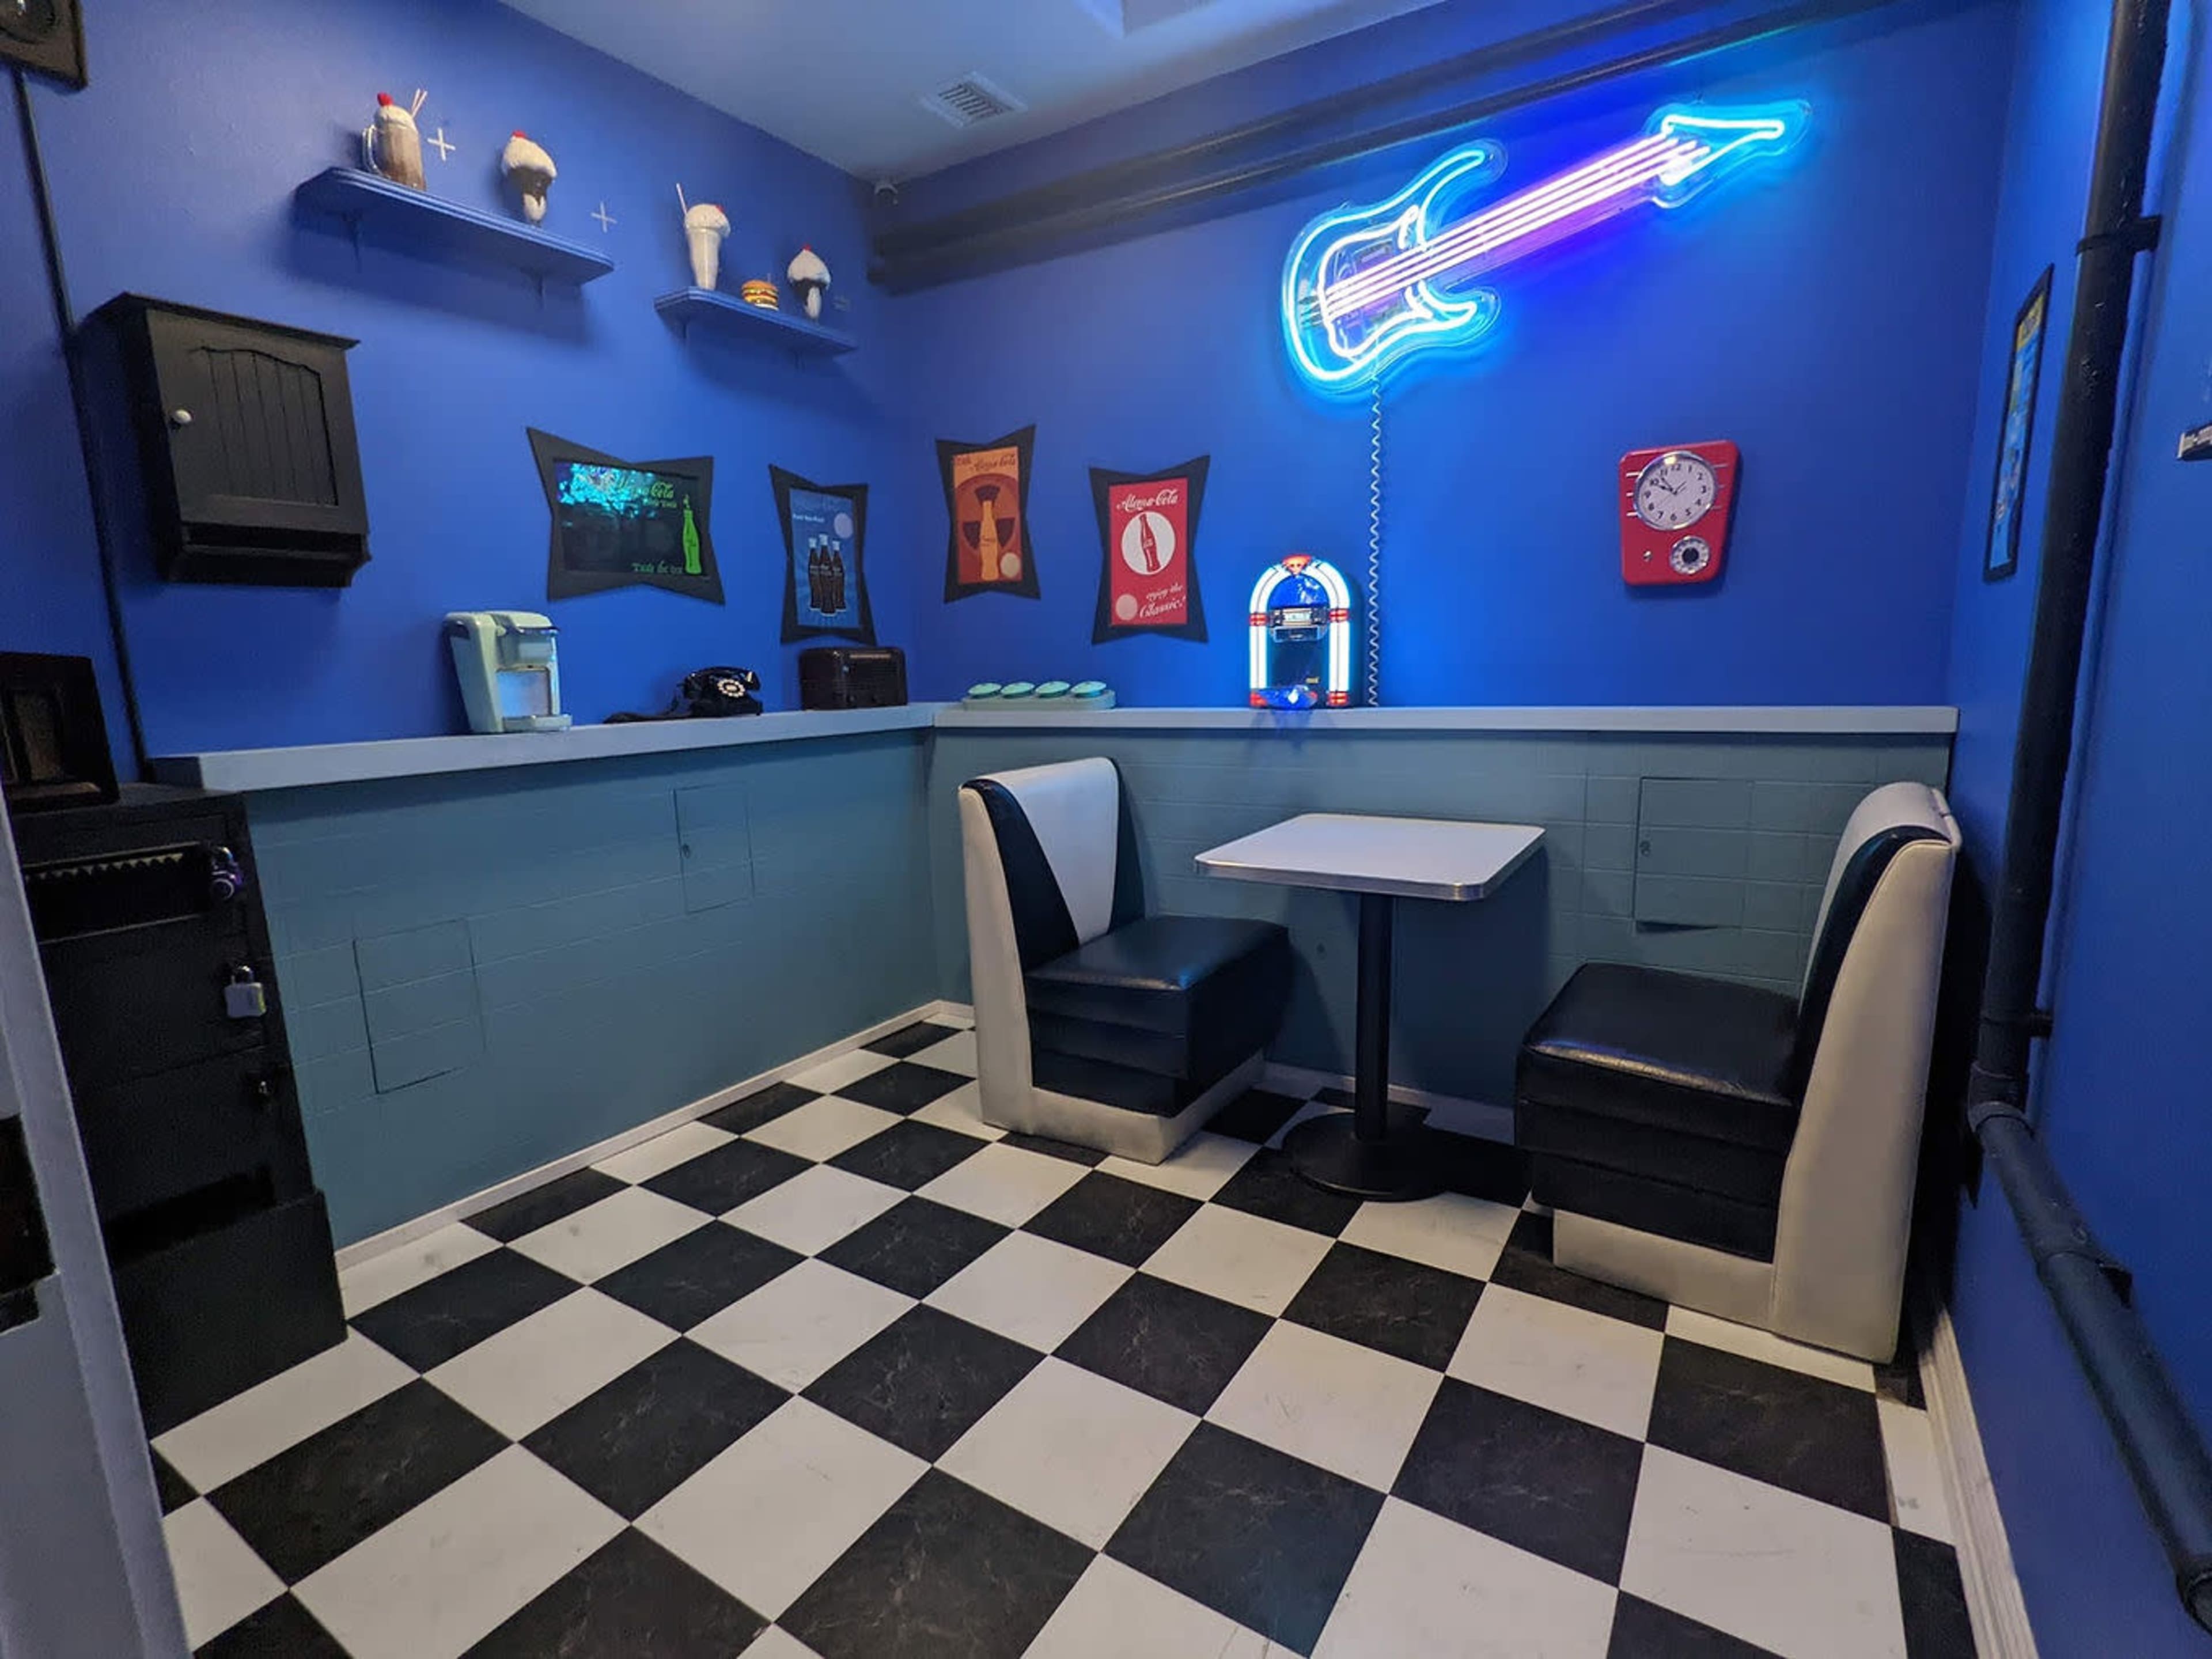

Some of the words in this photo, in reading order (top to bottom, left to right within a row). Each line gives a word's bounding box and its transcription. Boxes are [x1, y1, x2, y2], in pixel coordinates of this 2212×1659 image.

[1688, 465, 1692, 473] 1
[1697, 472, 1703, 480] 2
[1649, 478, 1659, 486] 10
[1702, 485, 1707, 494] 3
[1645, 490, 1652, 499] 9
[1648, 502, 1655, 511] 8
[1695, 498, 1702, 506] 4
[1658, 510, 1664, 519] 7
[1685, 507, 1692, 516] 5
[1670, 513, 1677, 521] 6
[1169, 582, 1183, 593] the
